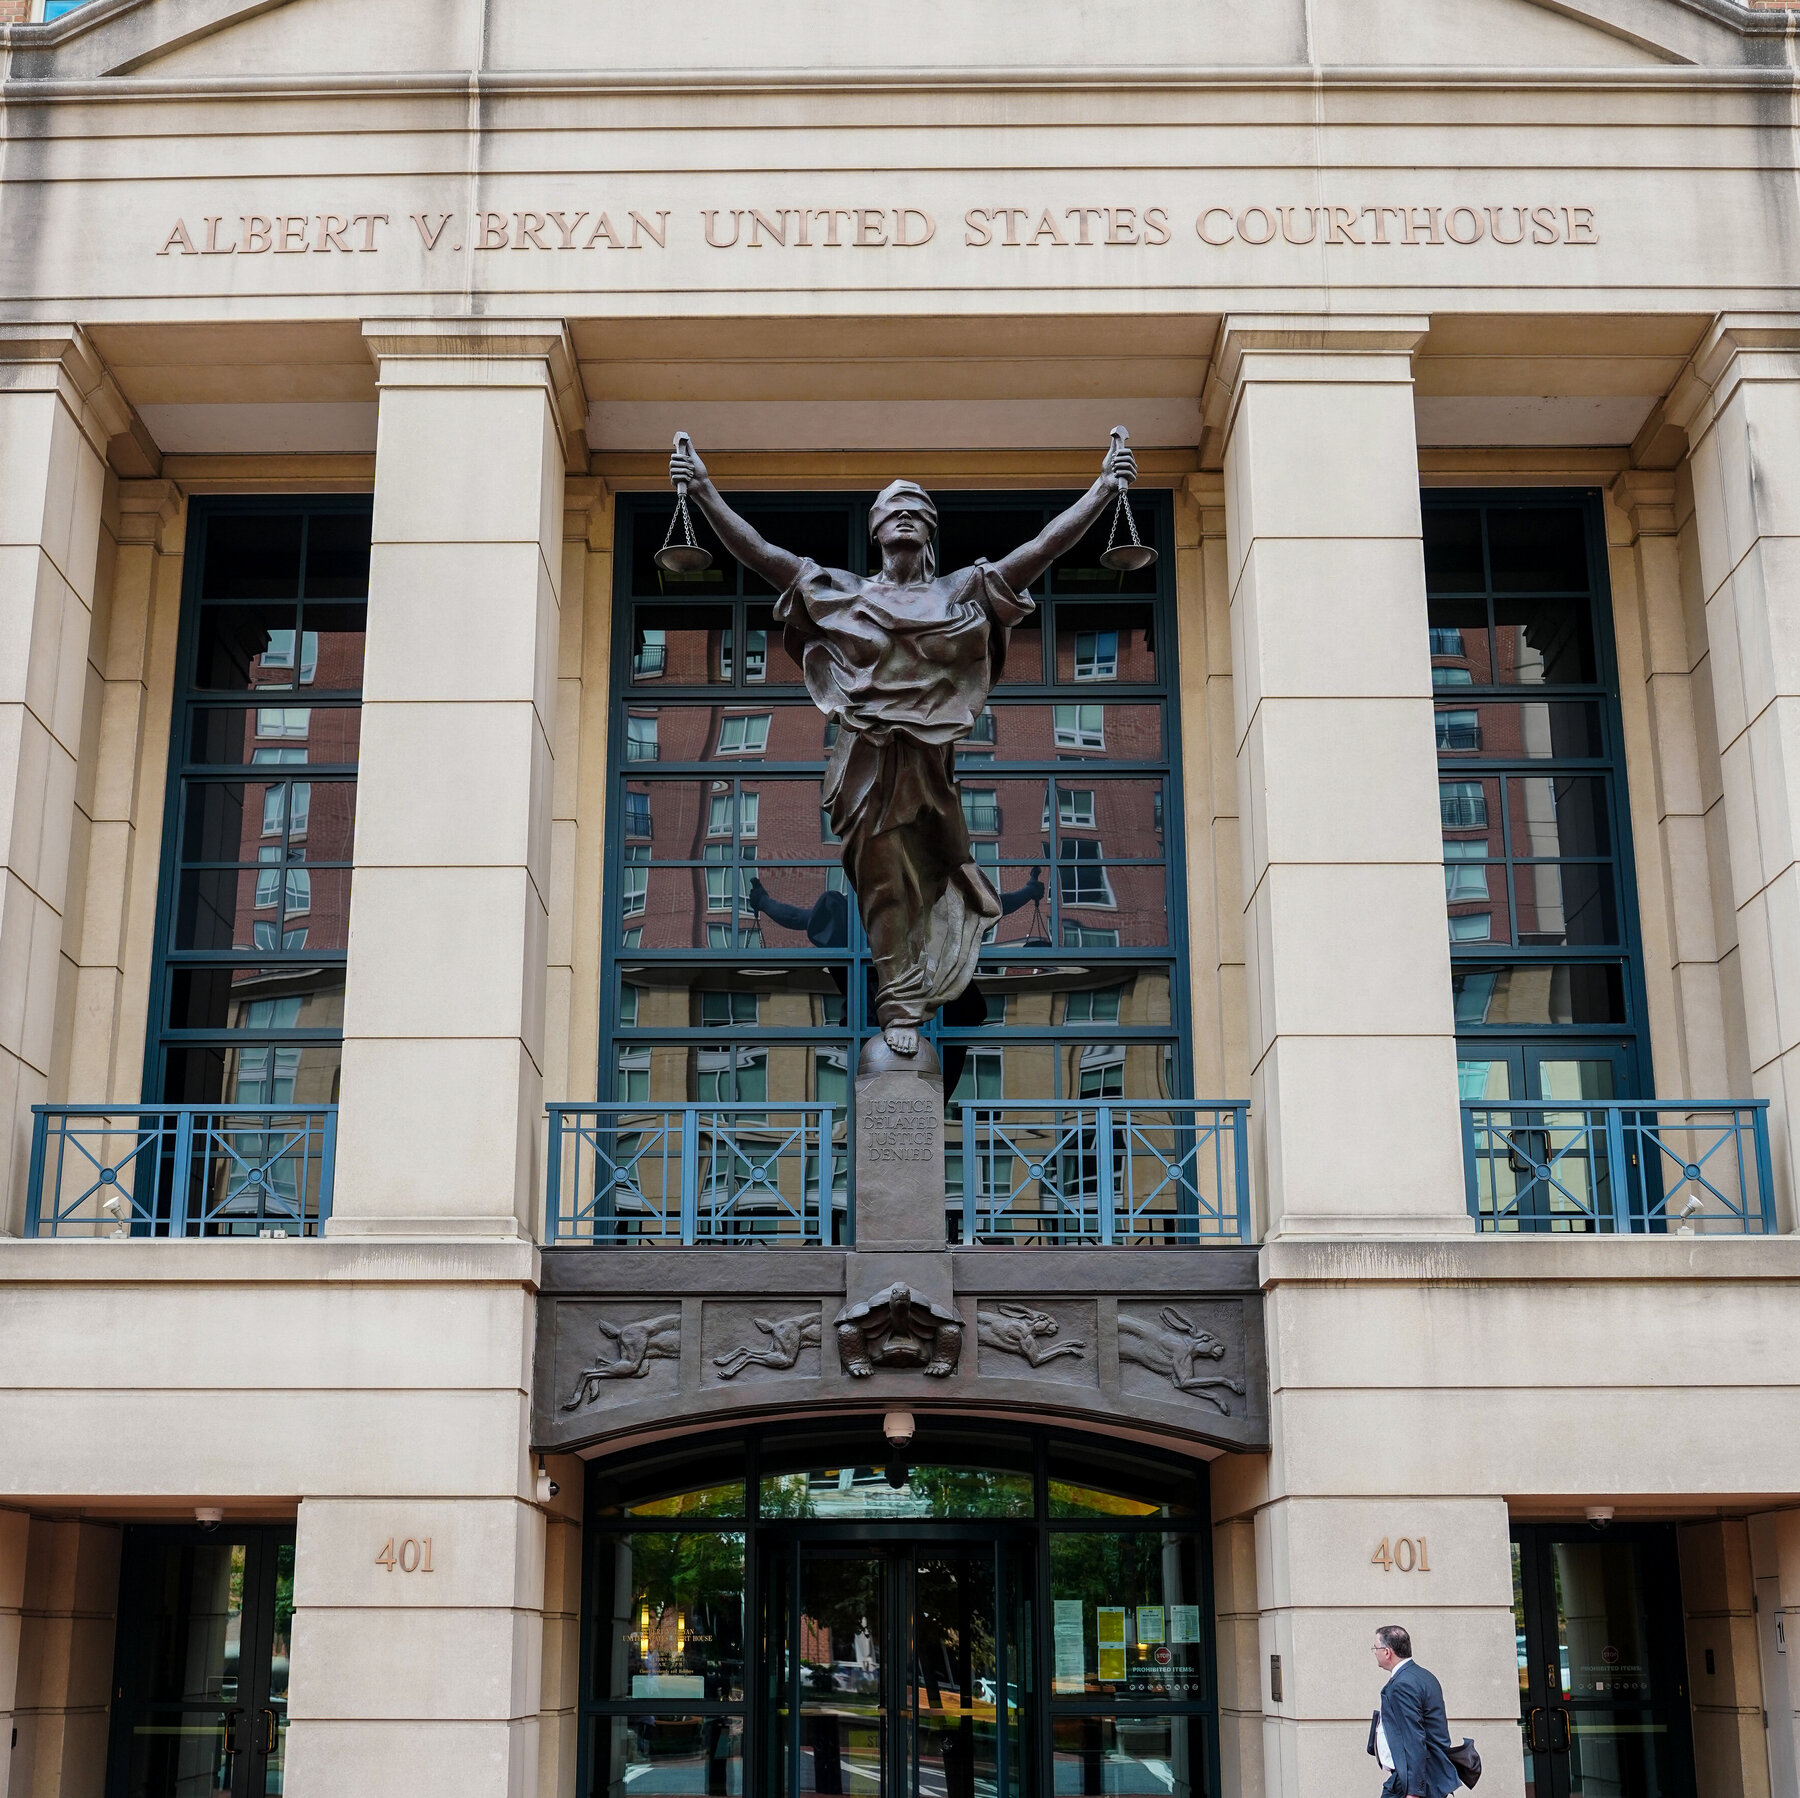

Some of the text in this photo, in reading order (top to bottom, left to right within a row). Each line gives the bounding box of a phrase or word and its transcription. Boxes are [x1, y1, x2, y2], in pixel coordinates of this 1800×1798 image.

[156, 206, 1600, 256] ALBERT V. BRYAN UNITED STATES COURTHOUSE
[867, 1100, 933, 1115] JUSTICE
[863, 1116, 938, 1129] DELAYED
[868, 1133, 934, 1147] JUSTICE
[868, 1148, 933, 1161] DENIED
[375, 1537, 434, 1572] 401
[1371, 1536, 1431, 1572] 401
